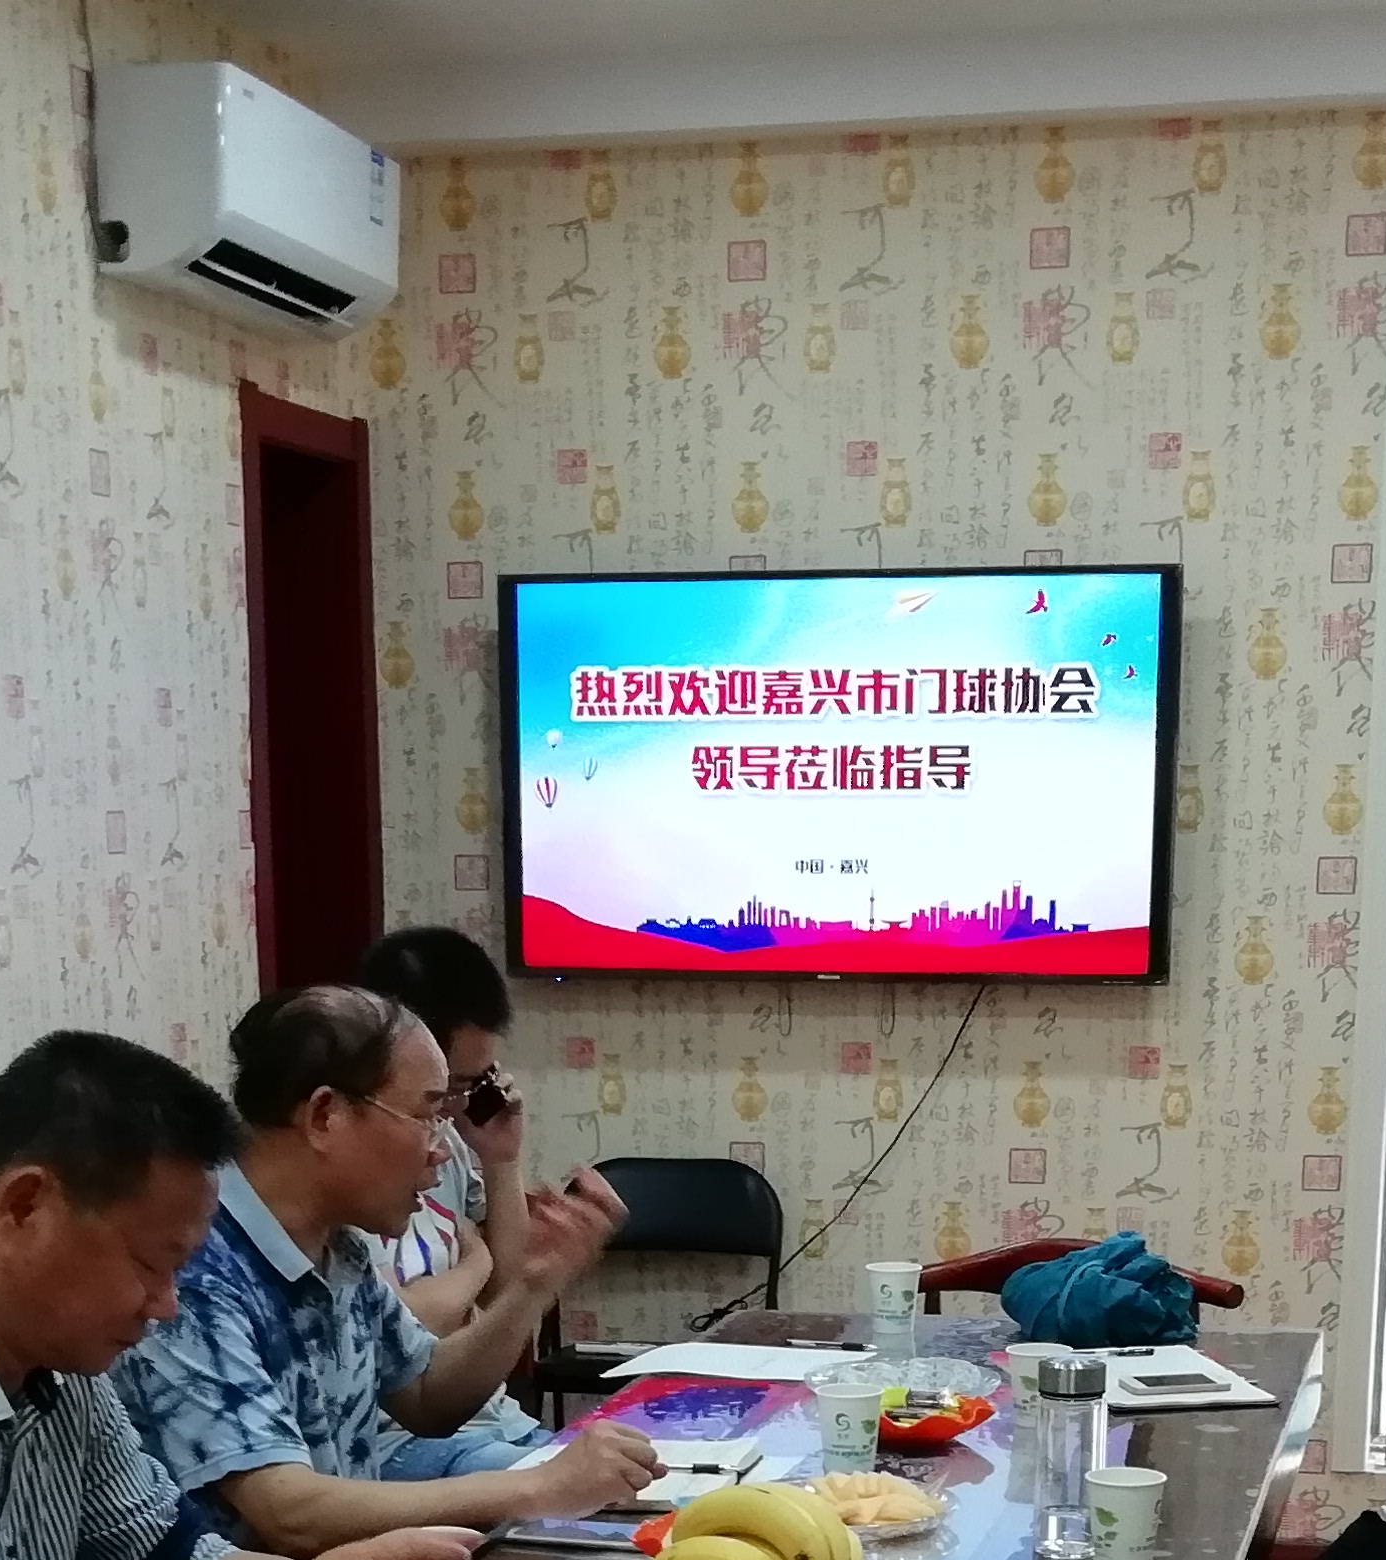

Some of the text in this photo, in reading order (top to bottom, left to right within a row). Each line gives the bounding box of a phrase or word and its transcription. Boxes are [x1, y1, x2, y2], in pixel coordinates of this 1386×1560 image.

[573, 666, 1097, 716] 热烈欢迎嘉兴市门球协会
[691, 744, 972, 791] 领导莅临指导
